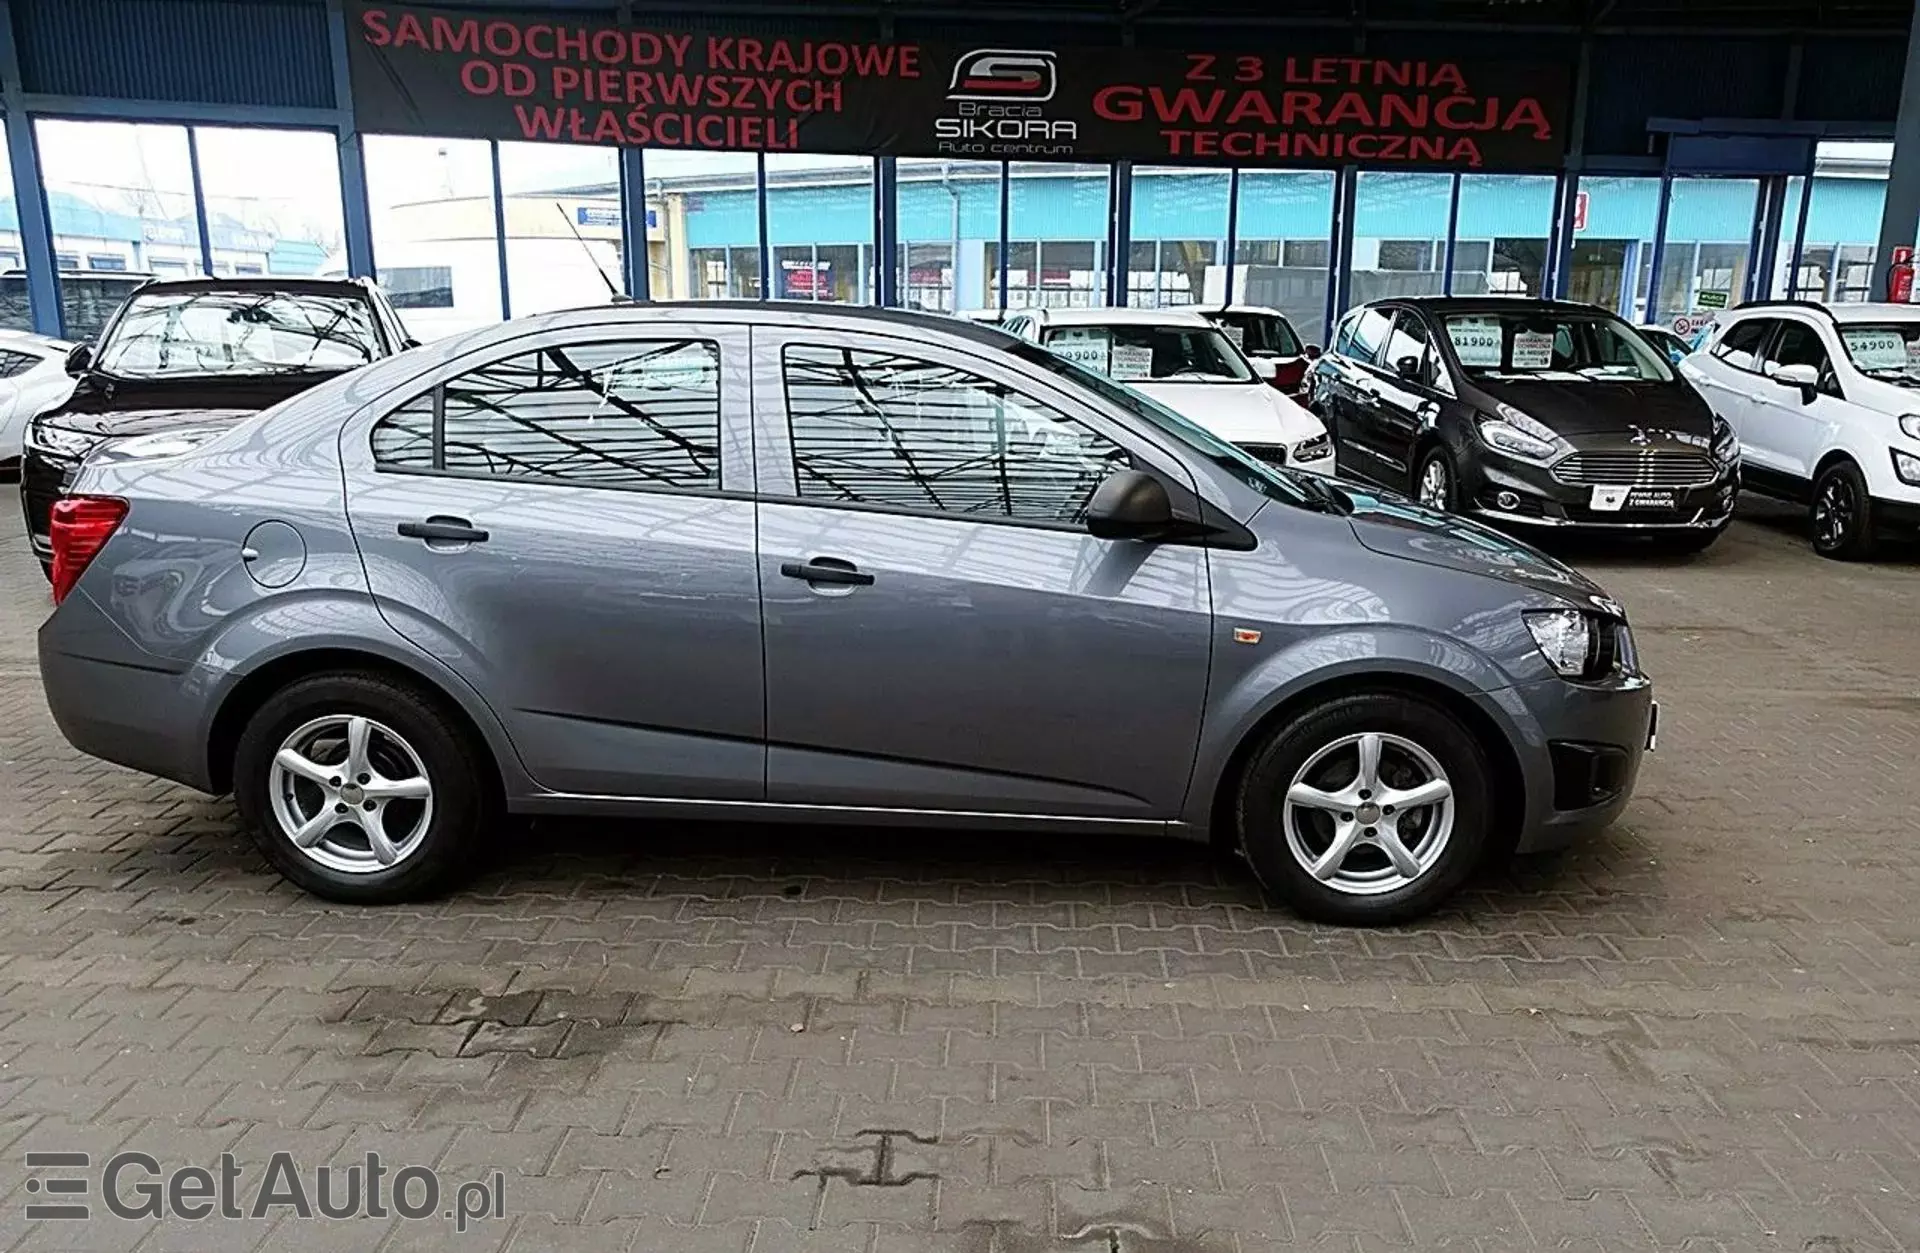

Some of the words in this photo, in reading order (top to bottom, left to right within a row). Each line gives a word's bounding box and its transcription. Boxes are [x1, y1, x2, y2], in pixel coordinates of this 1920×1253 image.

[362, 10, 692, 68] SAMOCHODY
[707, 36, 920, 78] KRAJOWE
[461, 60, 537, 97] OD
[553, 67, 842, 112] PIERWSZYCH
[1185, 54, 1216, 81] Z
[1234, 56, 1264, 82] 3
[1285, 57, 1468, 93] LETNIĄ
[515, 103, 800, 149] WŁAŚCICIELI
[958, 102, 1042, 117] Bracia
[1092, 85, 1552, 140] GWARANCJĄ
[935, 118, 1077, 140] SIKORA
[938, 141, 985, 153] Auto
[990, 143, 1074, 154] centrum
[1160, 130, 1482, 166] TECHNICZNĄ
[1454, 336, 1494, 347] 81900
[1850, 340, 1895, 351] 54900
